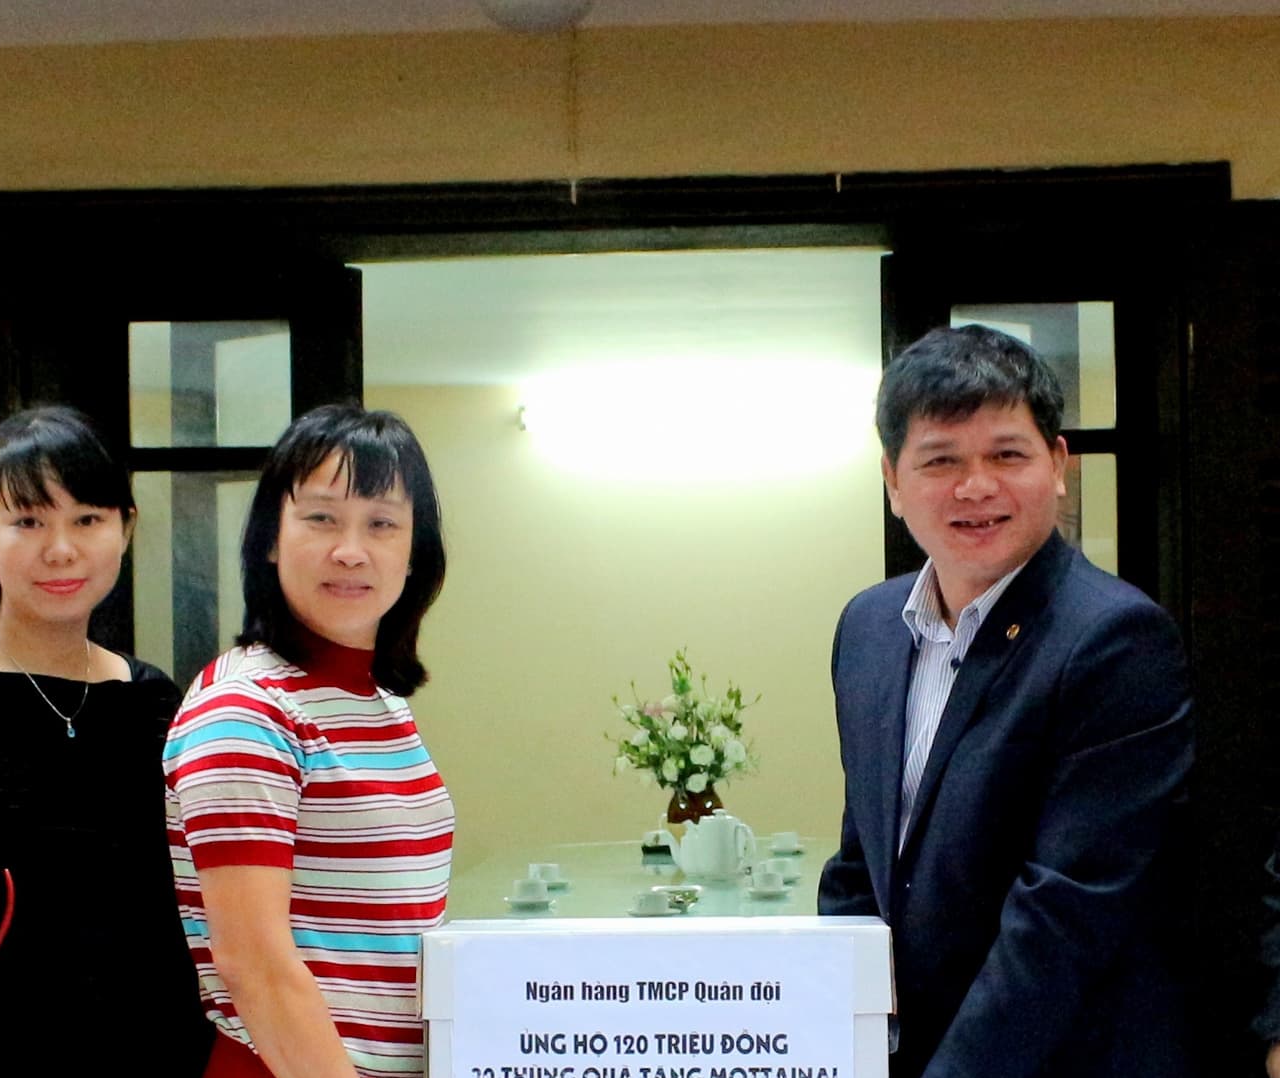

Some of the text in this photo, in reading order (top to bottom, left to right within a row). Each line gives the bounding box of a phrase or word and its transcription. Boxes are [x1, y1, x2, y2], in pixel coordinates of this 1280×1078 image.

[526, 981, 781, 1004] Ngân hàng TMCP Quân đội
[574, 1031, 607, 1058] HỘ
[614, 1034, 648, 1054] 120
[654, 1031, 714, 1058] TRIỆU
